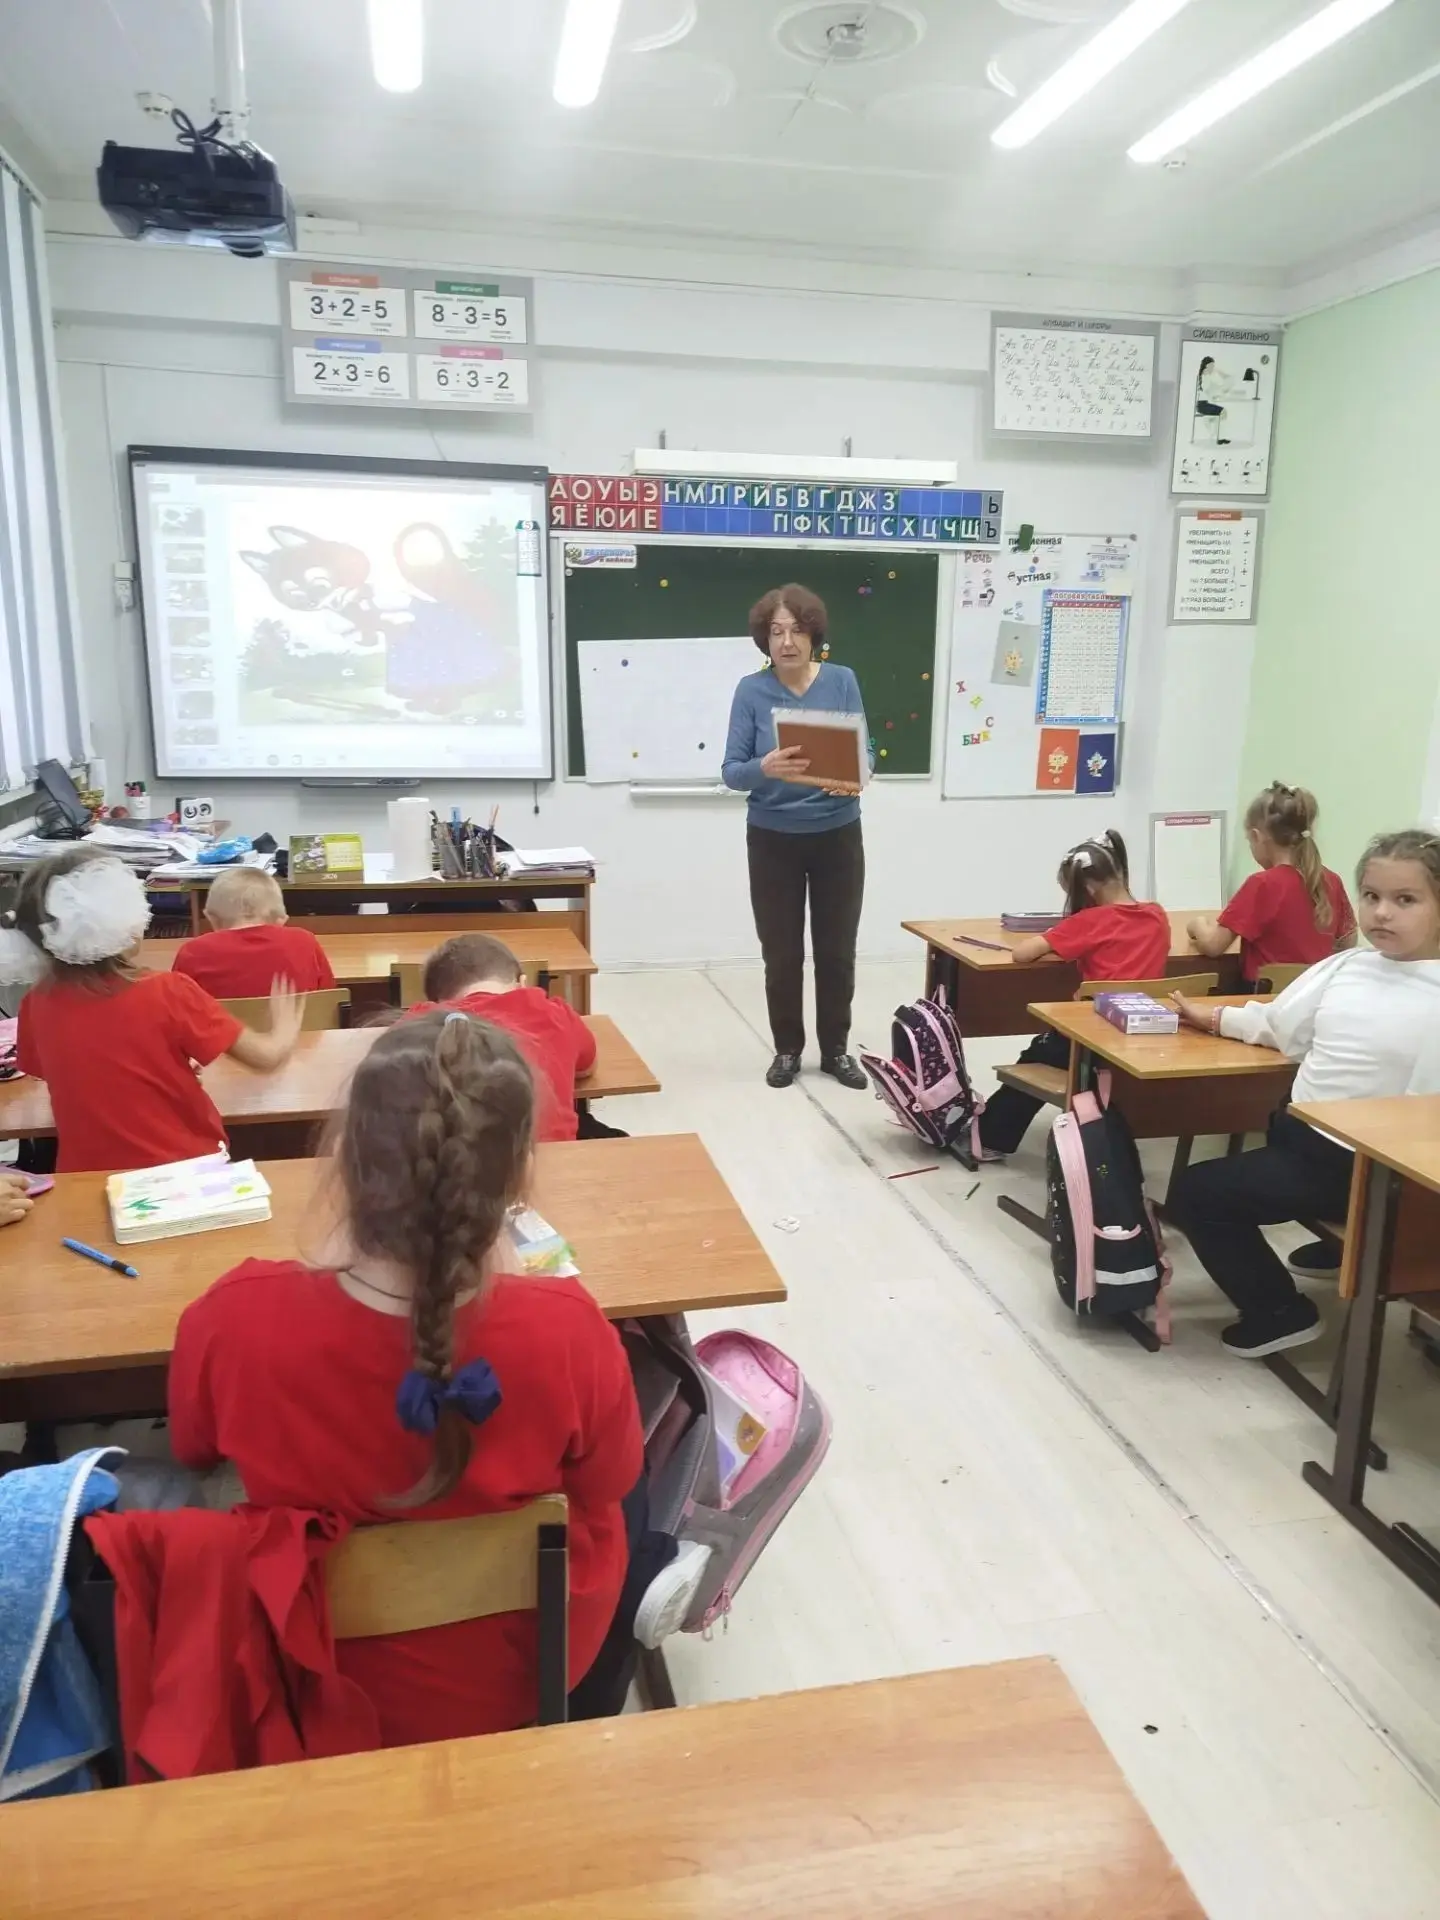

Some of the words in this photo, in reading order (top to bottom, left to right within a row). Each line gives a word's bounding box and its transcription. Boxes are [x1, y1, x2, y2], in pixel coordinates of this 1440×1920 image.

[1220, 331, 1269, 341] ПРАВИЛЬНО
[1008, 537, 1062, 546] пименная
[964, 550, 992, 564] Речь
[1016, 572, 1051, 586] устная
